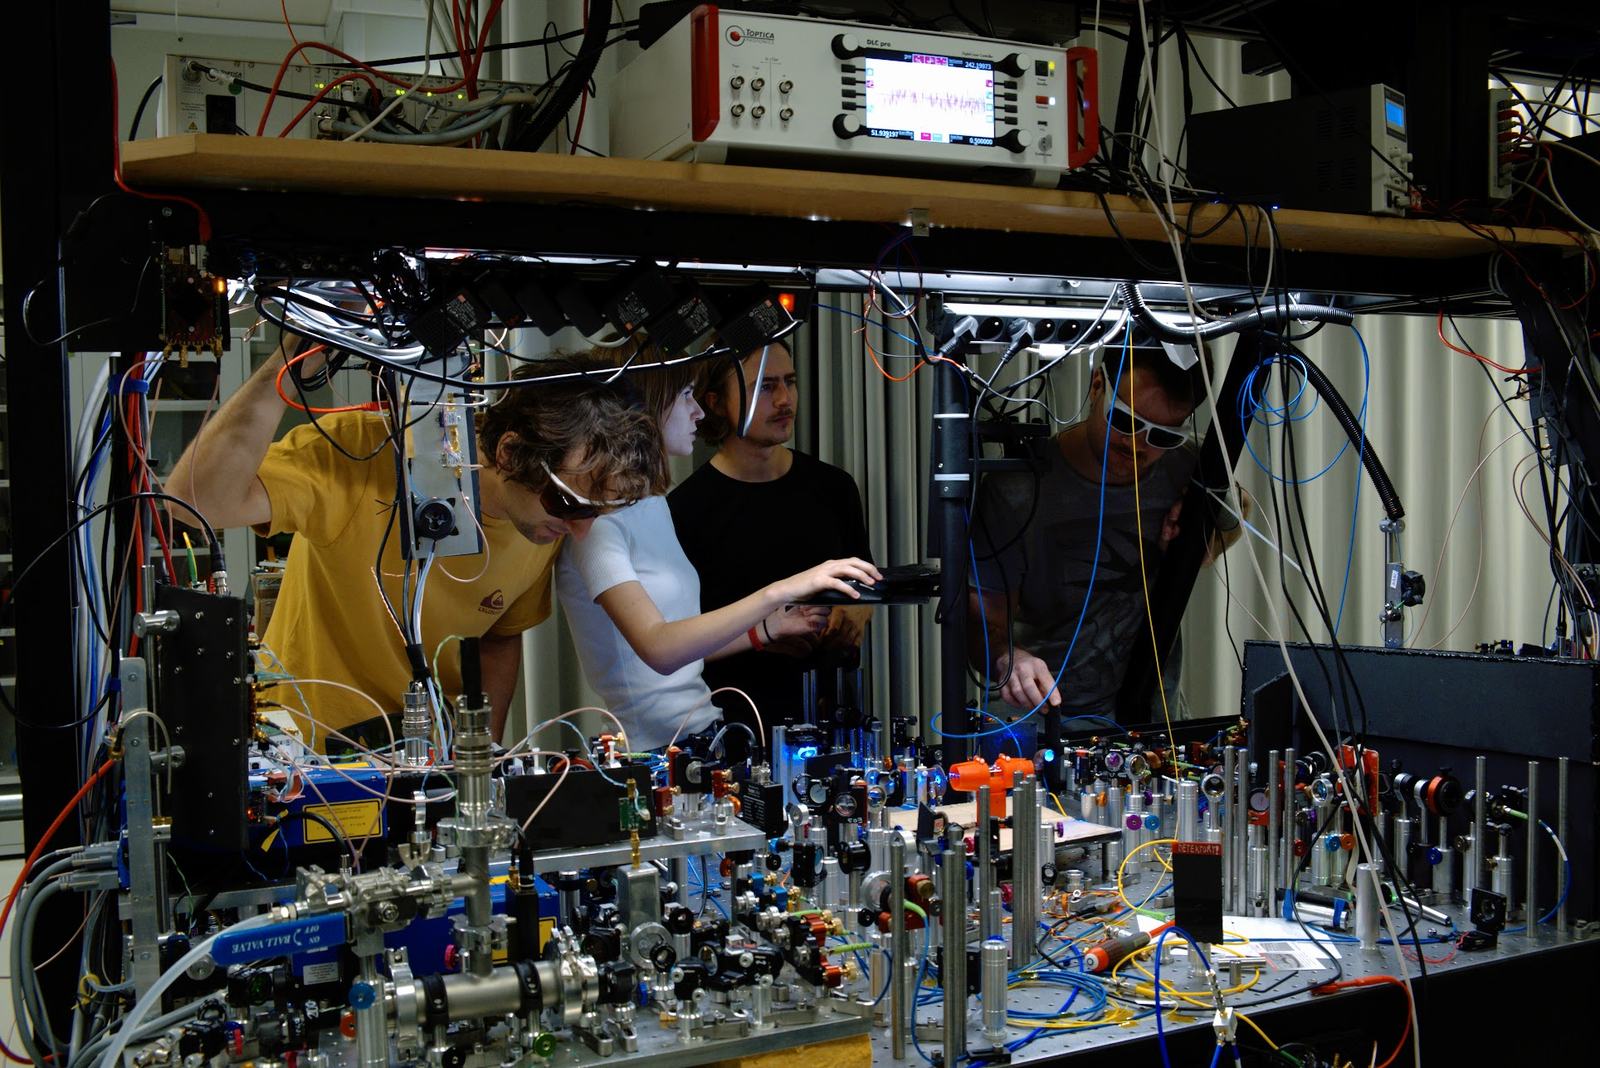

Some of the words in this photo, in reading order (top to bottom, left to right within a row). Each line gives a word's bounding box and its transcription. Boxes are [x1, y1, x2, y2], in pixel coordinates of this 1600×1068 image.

[746, 29, 775, 39] TOPTICA
[304, 925, 319, 935] OFF
[265, 934, 291, 947] BALL
[308, 936, 320, 945] ON
[231, 942, 263, 954] VALVE
